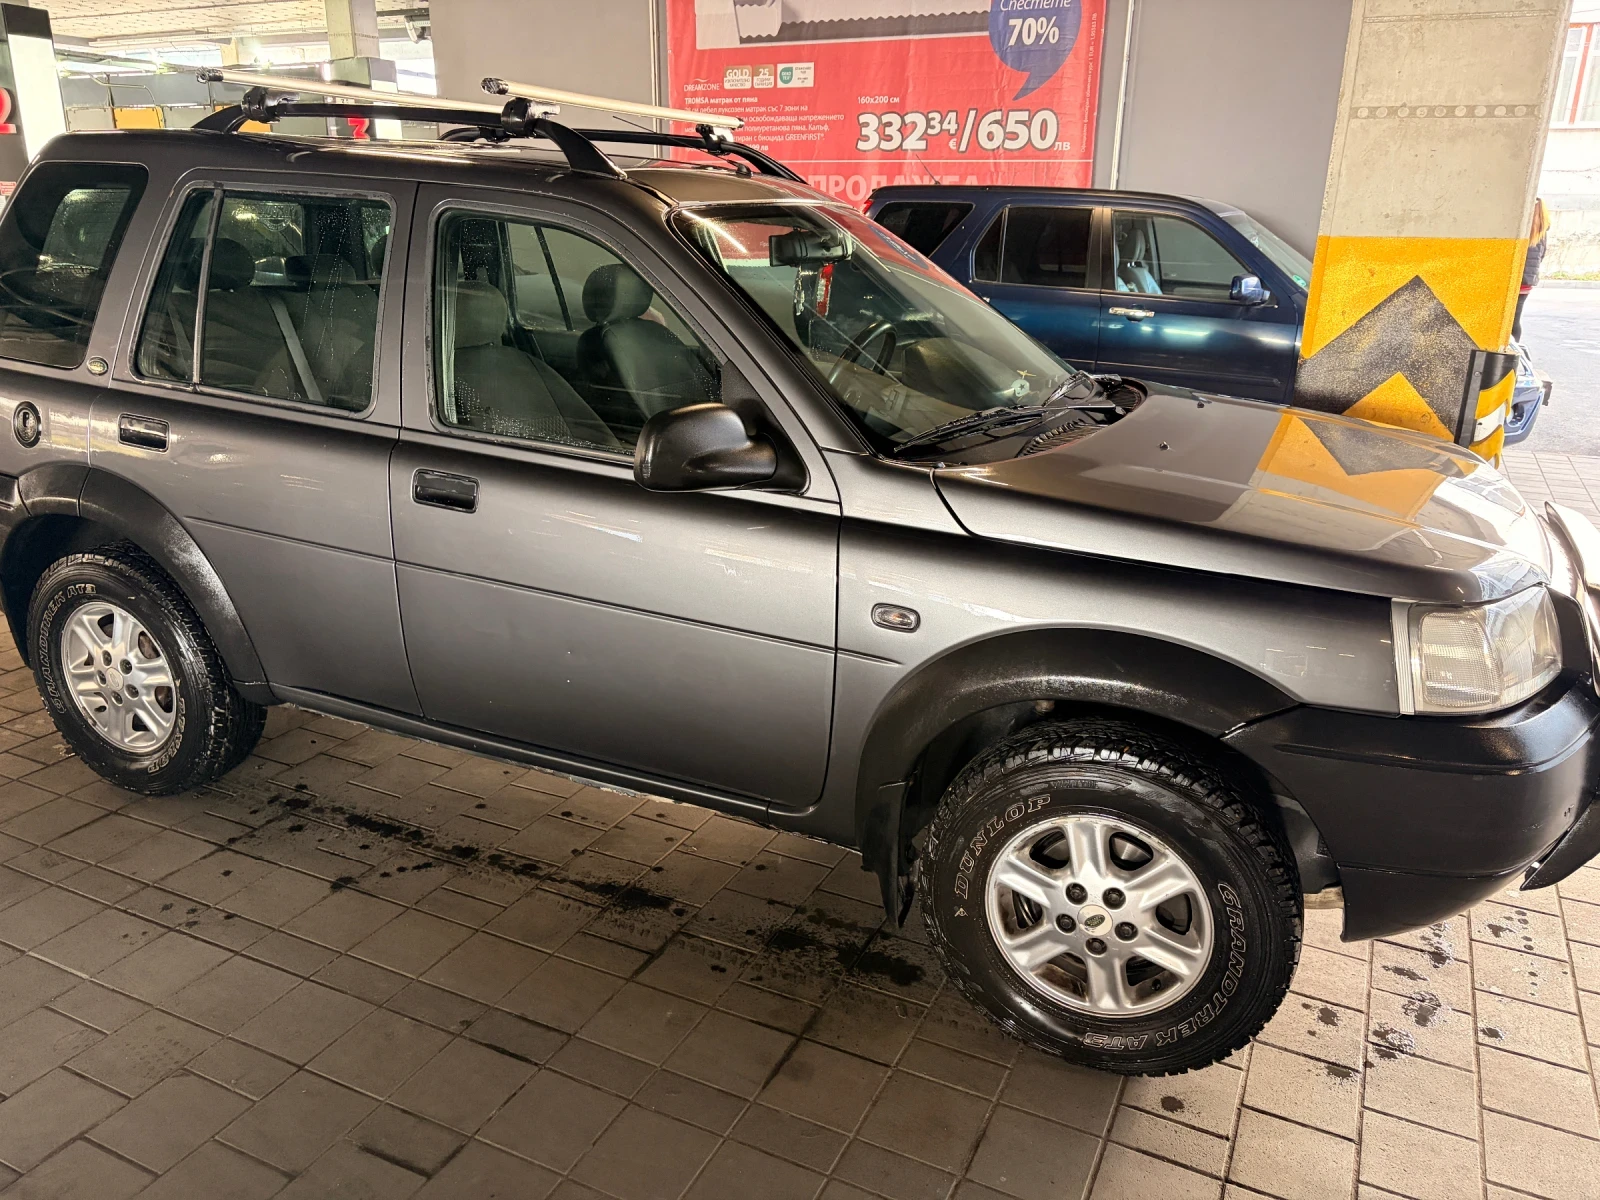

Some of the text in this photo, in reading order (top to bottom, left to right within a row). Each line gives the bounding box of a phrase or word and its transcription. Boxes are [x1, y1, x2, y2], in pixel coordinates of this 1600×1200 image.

[1008, 16, 1060, 46] 70%
[726, 68, 750, 78] GOLD
[759, 68, 769, 77] 25
[684, 83, 720, 92] DREAMZONE
[710, 97, 733, 105] матрак
[857, 96, 888, 104] 160x200
[745, 106, 767, 114] матрак
[748, 114, 798, 122] освобождаваща
[798, 114, 845, 122] напрежението
[744, 125, 790, 133] полиуретанова
[808, 123, 829, 132] Калъф,
[757, 134, 785, 142] биоцида
[954, 794, 1051, 900] DUNLOP
[1083, 882, 1247, 1051] GRANDTREK AT3
